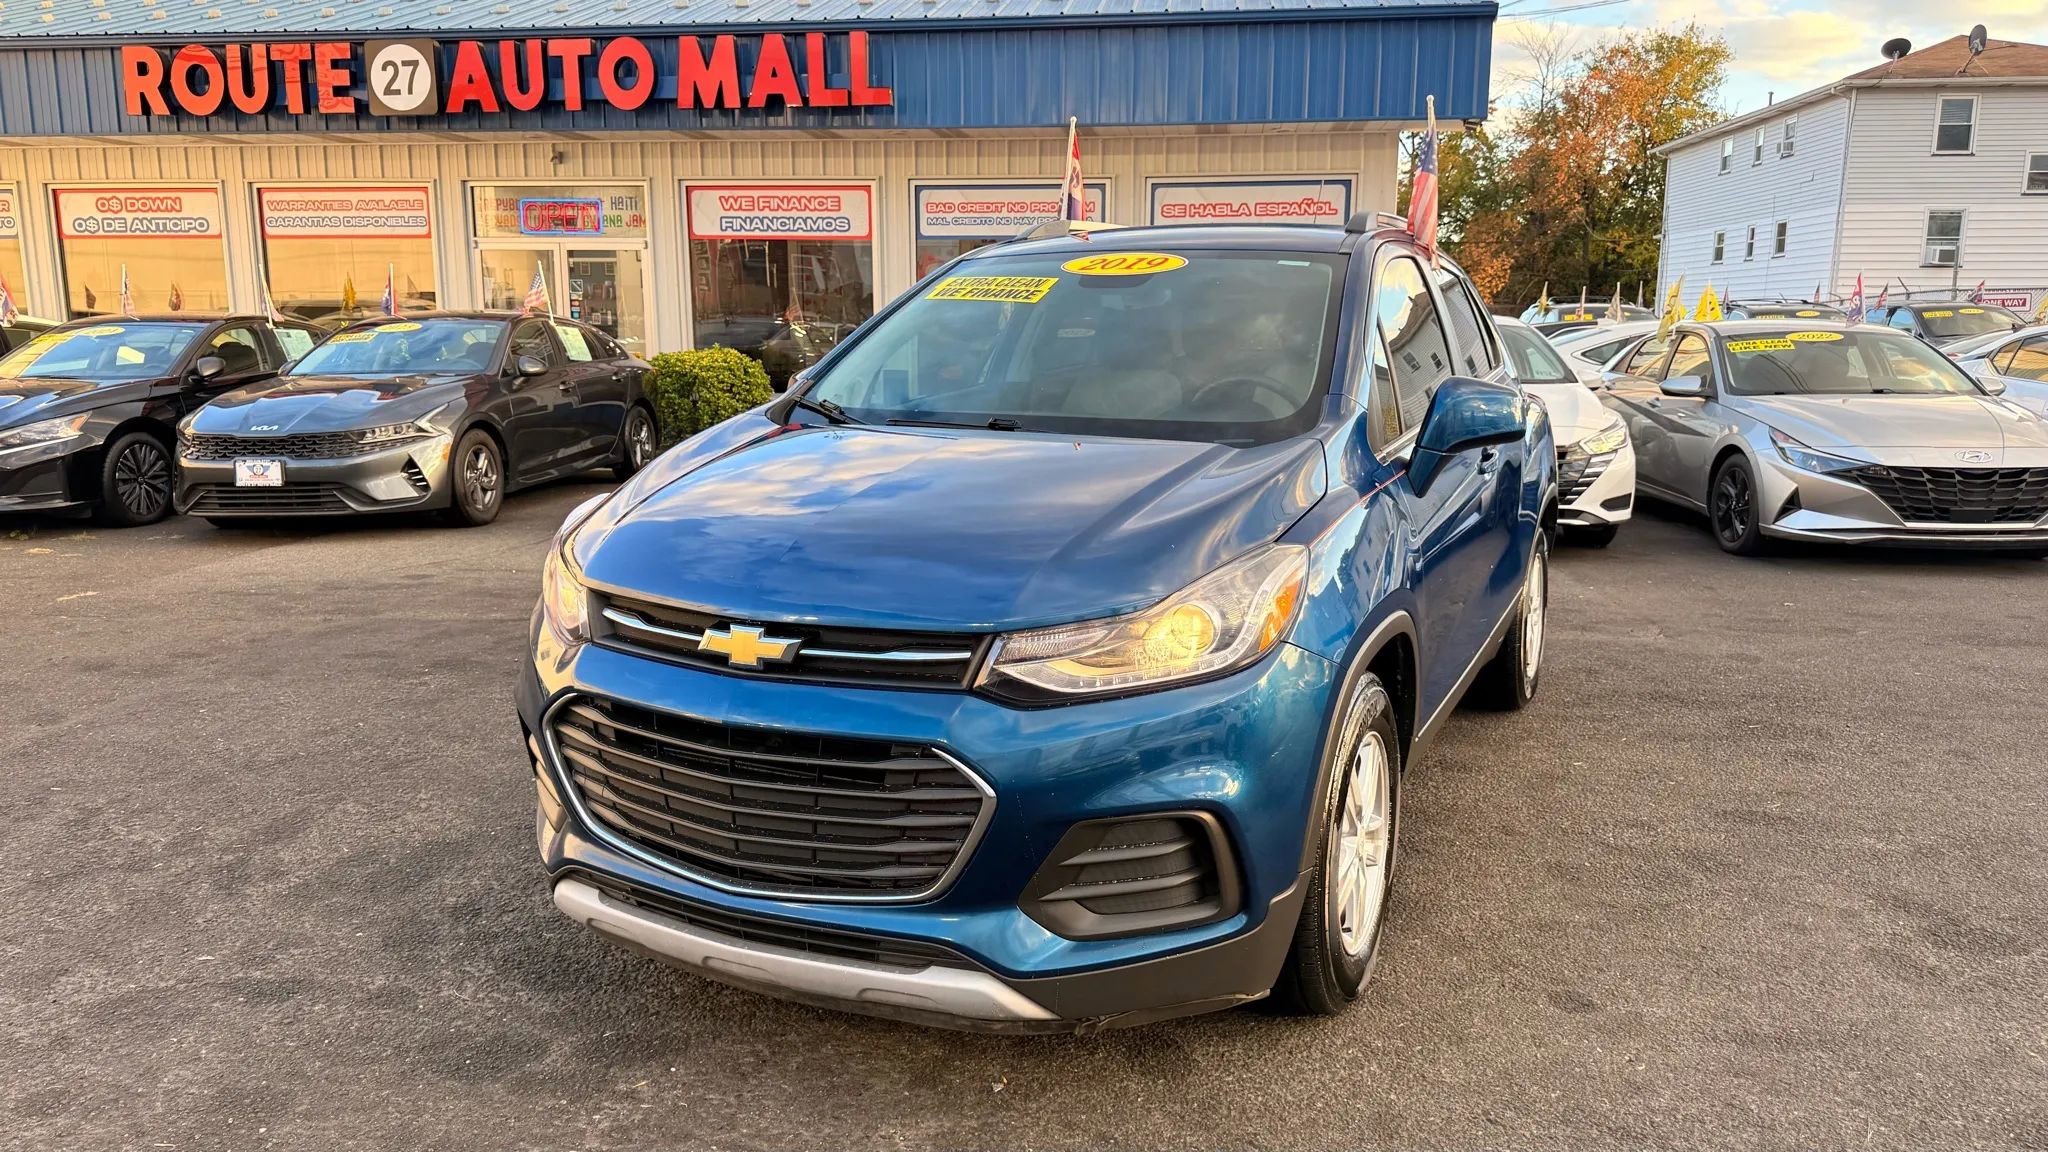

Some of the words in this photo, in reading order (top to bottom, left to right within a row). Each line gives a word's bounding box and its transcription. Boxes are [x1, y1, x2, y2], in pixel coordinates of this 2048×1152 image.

[121, 42, 355, 115] ROUTE
[381, 60, 419, 97] 27
[445, 36, 655, 113] AUTO
[677, 31, 892, 110] MALL
[125, 197, 182, 212] DOWN
[267, 200, 352, 211] WARRANTIES
[355, 200, 424, 211] AVAILABLE
[719, 196, 754, 211] WE
[757, 196, 841, 211] FINANCE
[926, 202, 954, 213] BAD
[957, 202, 1005, 213] CREDIT
[1008, 202, 1029, 213] NO
[1161, 204, 1186, 217] SE
[1189, 203, 1251, 217] HABLA
[1255, 198, 1337, 216] ESPAÑOL
[266, 216, 341, 227] GARANTIAS
[343, 216, 427, 227] DISPONIBLES
[523, 202, 600, 232] OPEN
[720, 216, 850, 232] FINANCIAMOS
[927, 217, 950, 225] MAL
[952, 217, 994, 225] CREDITO
[997, 217, 1012, 225] NO
[1013, 216, 1036, 226] HAY
[101, 217, 127, 232] DE
[129, 217, 209, 232] ANTICIPO
[1078, 257, 1169, 271] 2019
[945, 278, 993, 288] EXTRA
[994, 278, 1051, 288] CLEAN
[932, 288, 968, 298] WE
[961, 288, 1043, 300] FINANCE
